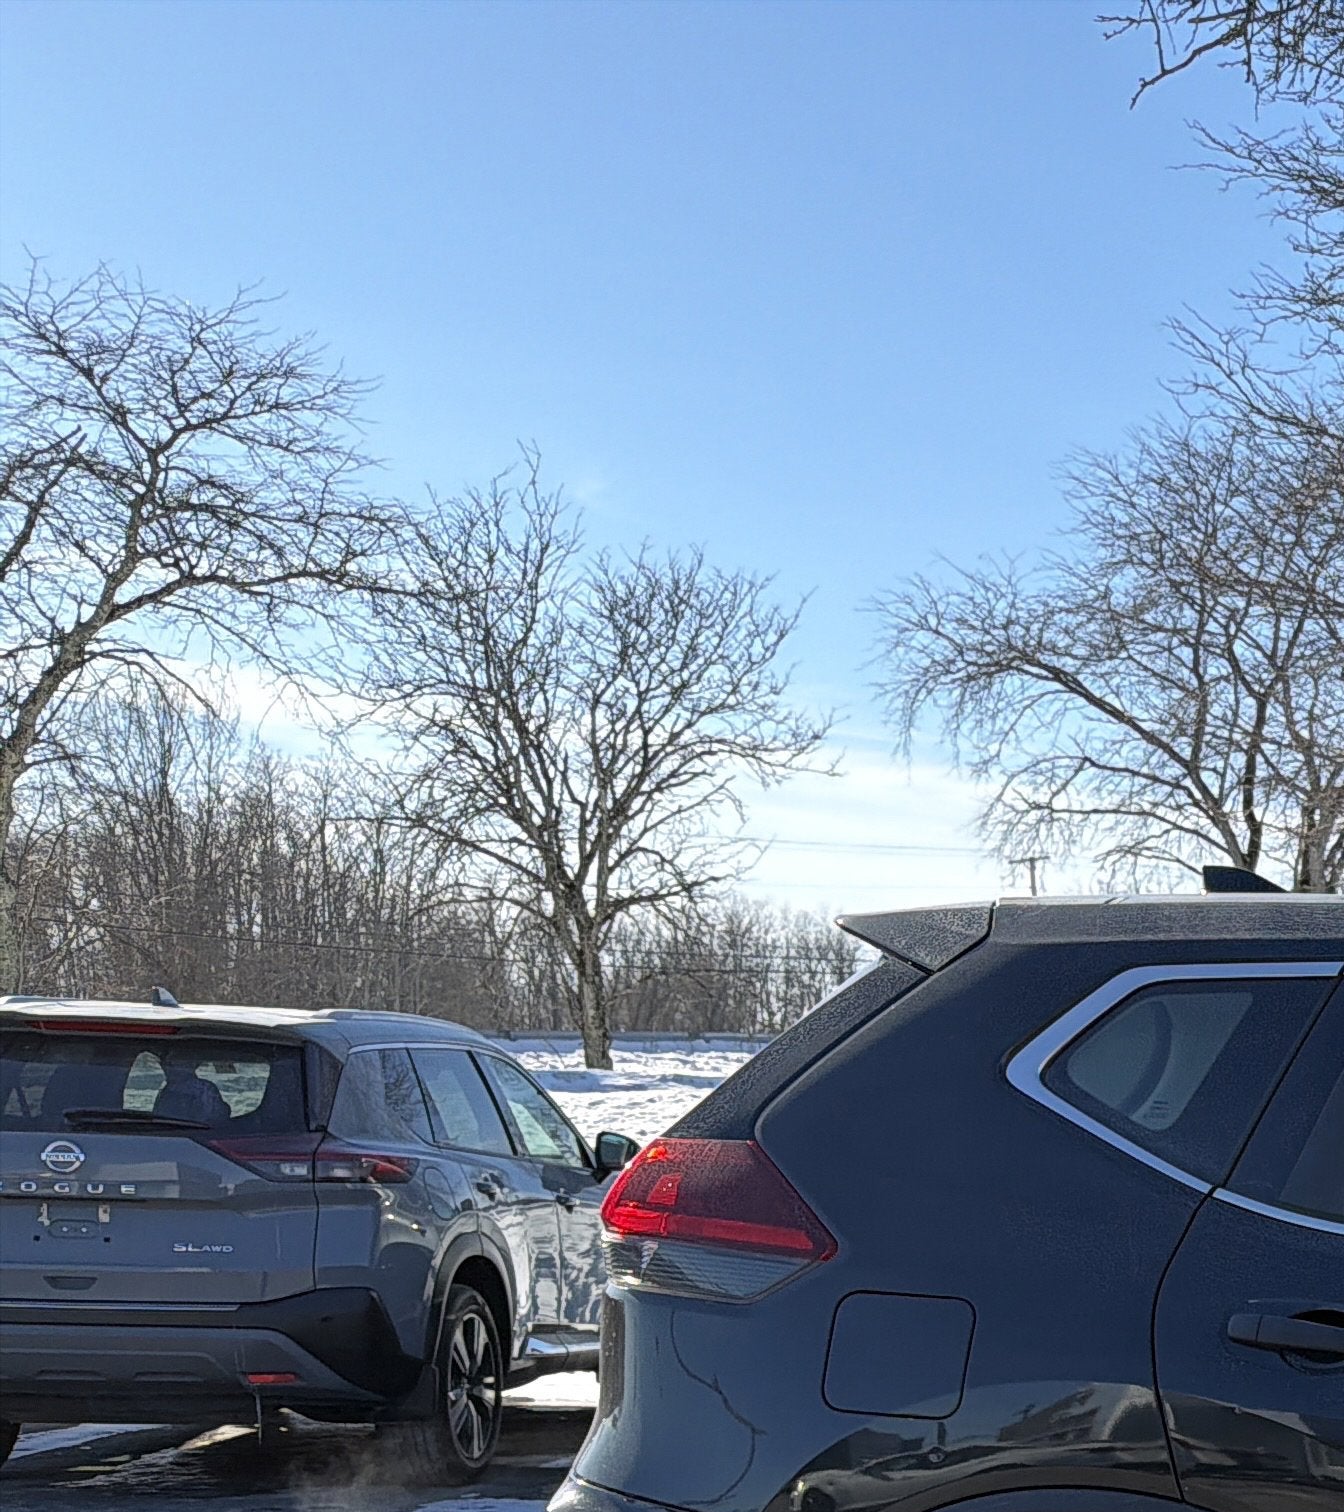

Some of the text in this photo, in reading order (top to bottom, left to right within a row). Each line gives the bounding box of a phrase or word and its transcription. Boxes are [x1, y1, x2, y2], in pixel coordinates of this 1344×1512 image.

[0, 1181, 137, 1195] OGUE
[172, 1243, 235, 1253] SL AWD
